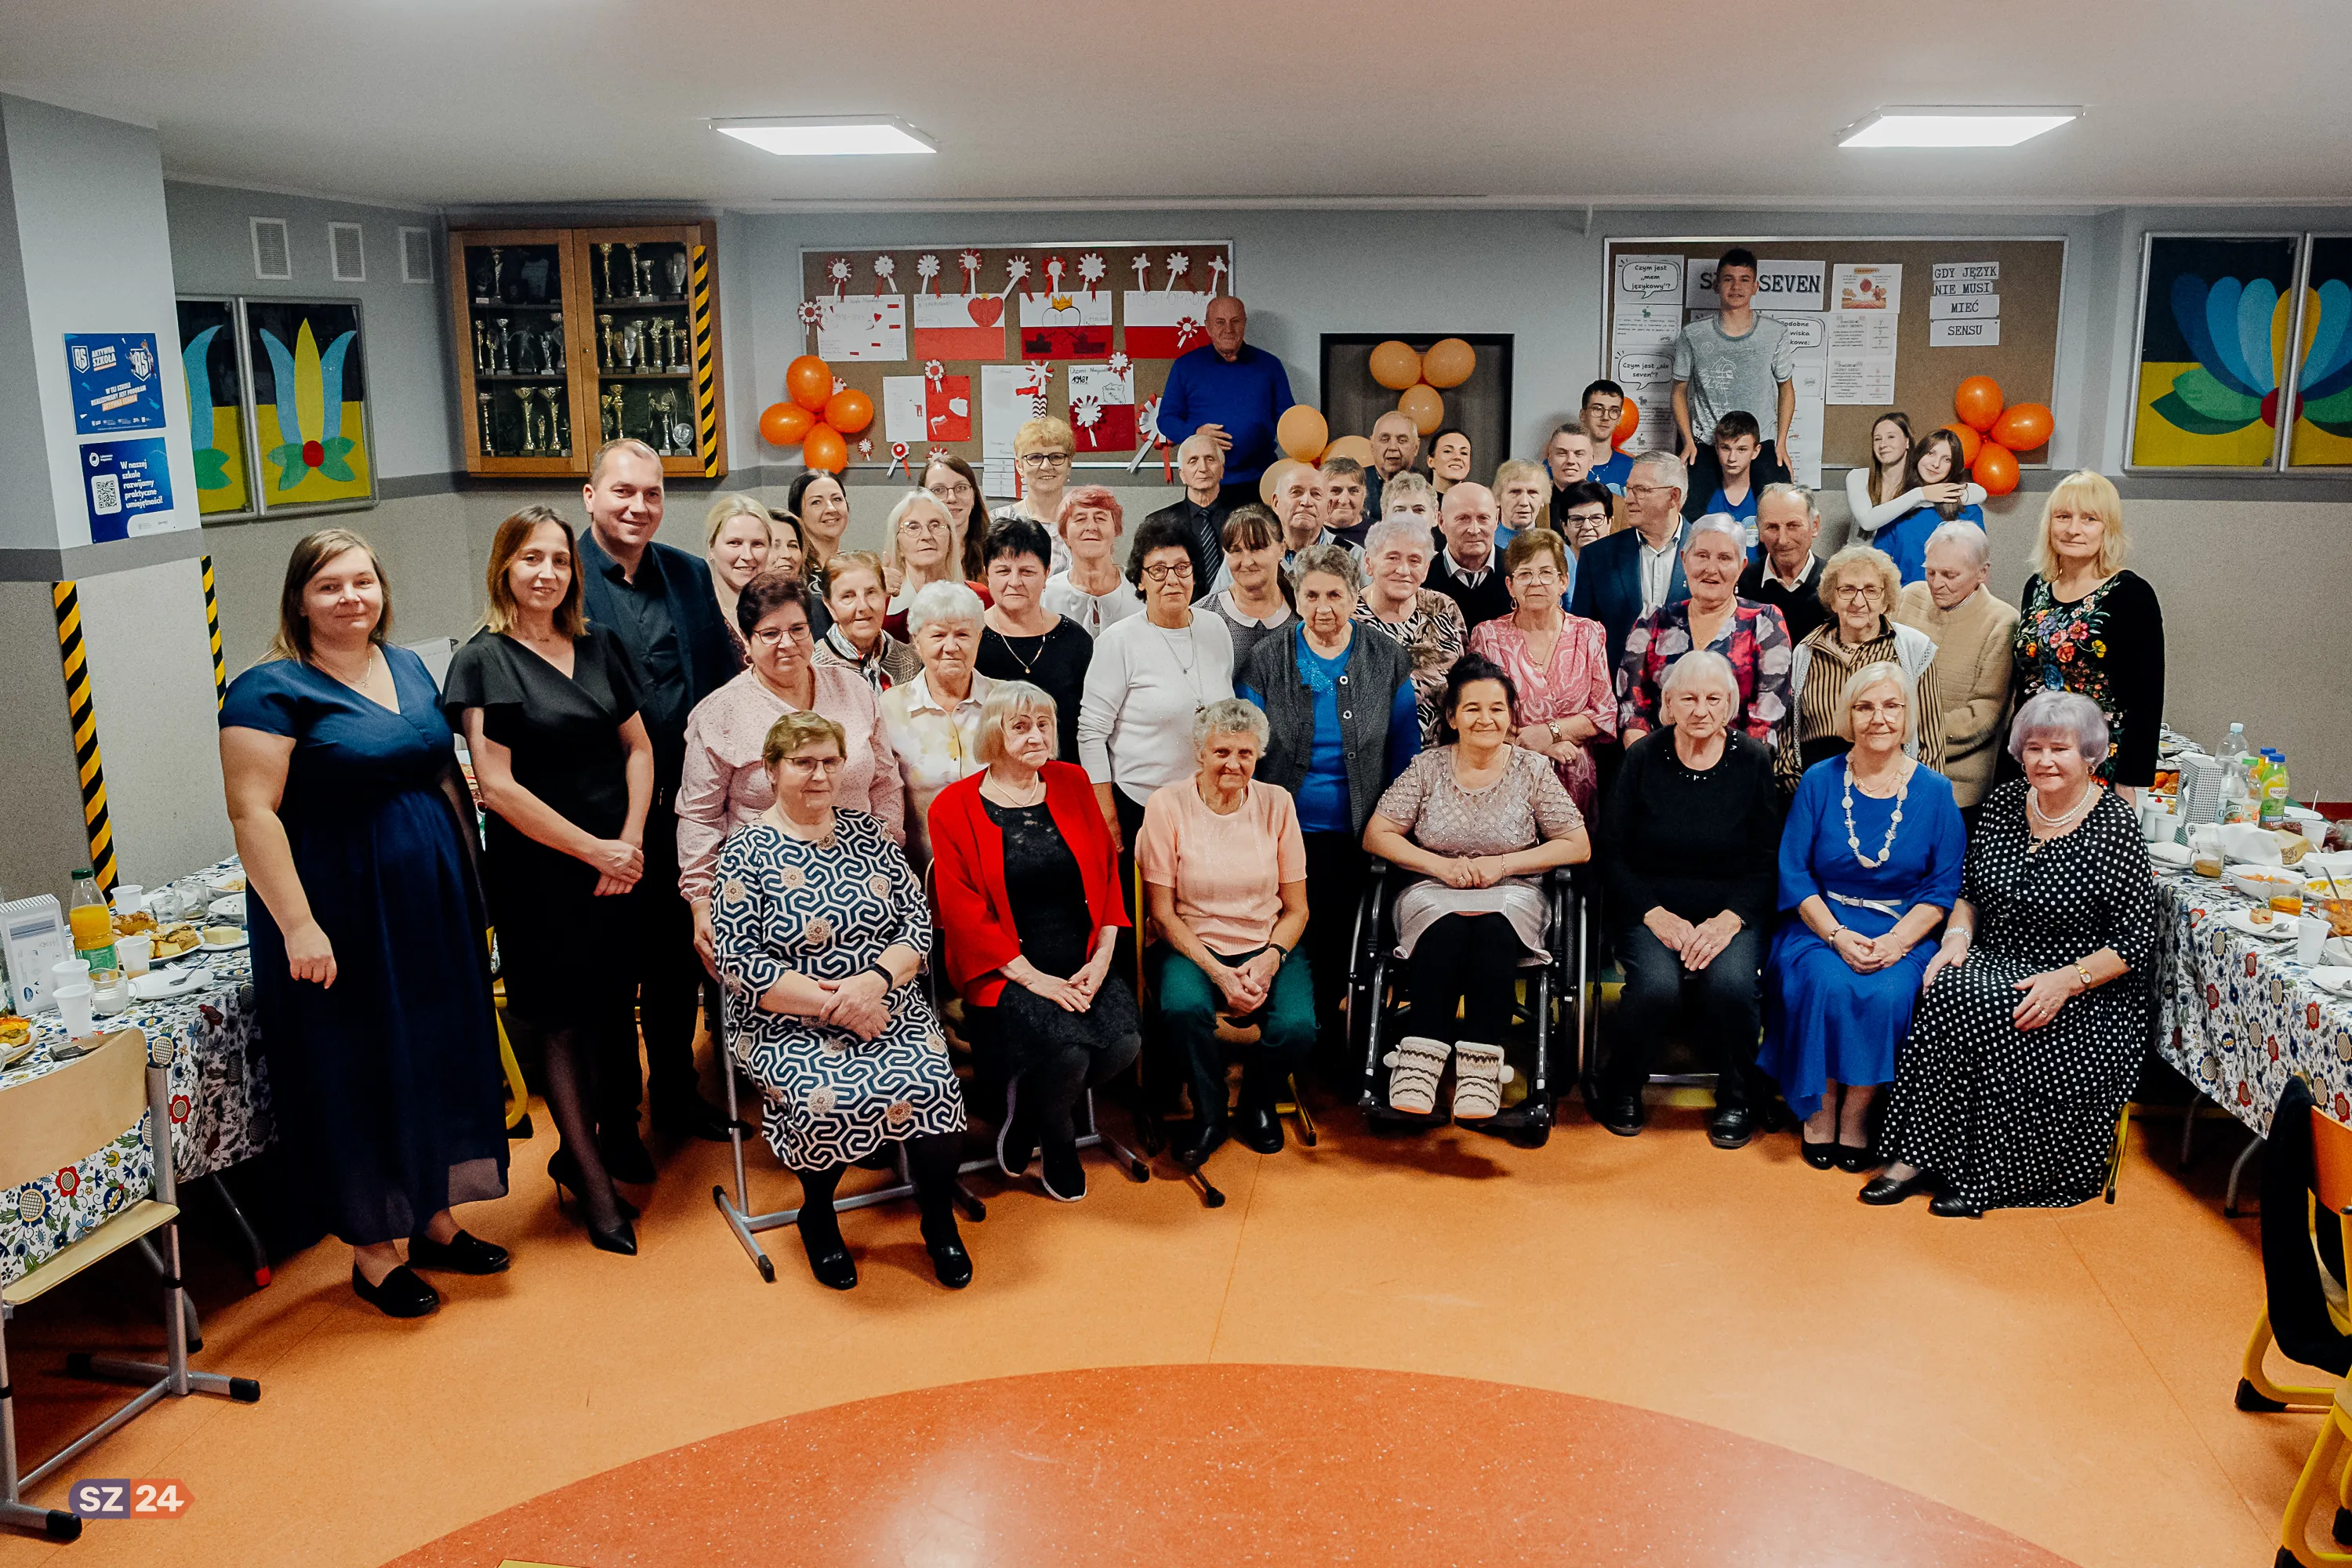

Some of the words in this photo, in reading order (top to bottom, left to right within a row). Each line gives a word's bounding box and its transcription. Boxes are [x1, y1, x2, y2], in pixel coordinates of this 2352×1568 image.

[1934, 267, 1955, 278] GDY
[1962, 266, 1997, 279] JĘZYK
[1759, 274, 1820, 293] SEVEN
[1935, 284, 1955, 295] NIE
[1962, 282, 1990, 293] MUSI
[1951, 299, 1979, 313] MIEĆ
[1947, 325, 1982, 336] SENSU
[1072, 376, 1088, 384] 1918!
[129, 459, 147, 469] naszej
[122, 470, 140, 479] szkole
[123, 479, 154, 489] rozwijamy
[125, 489, 157, 500] praktyczne
[126, 495, 163, 508] umiejętności!
